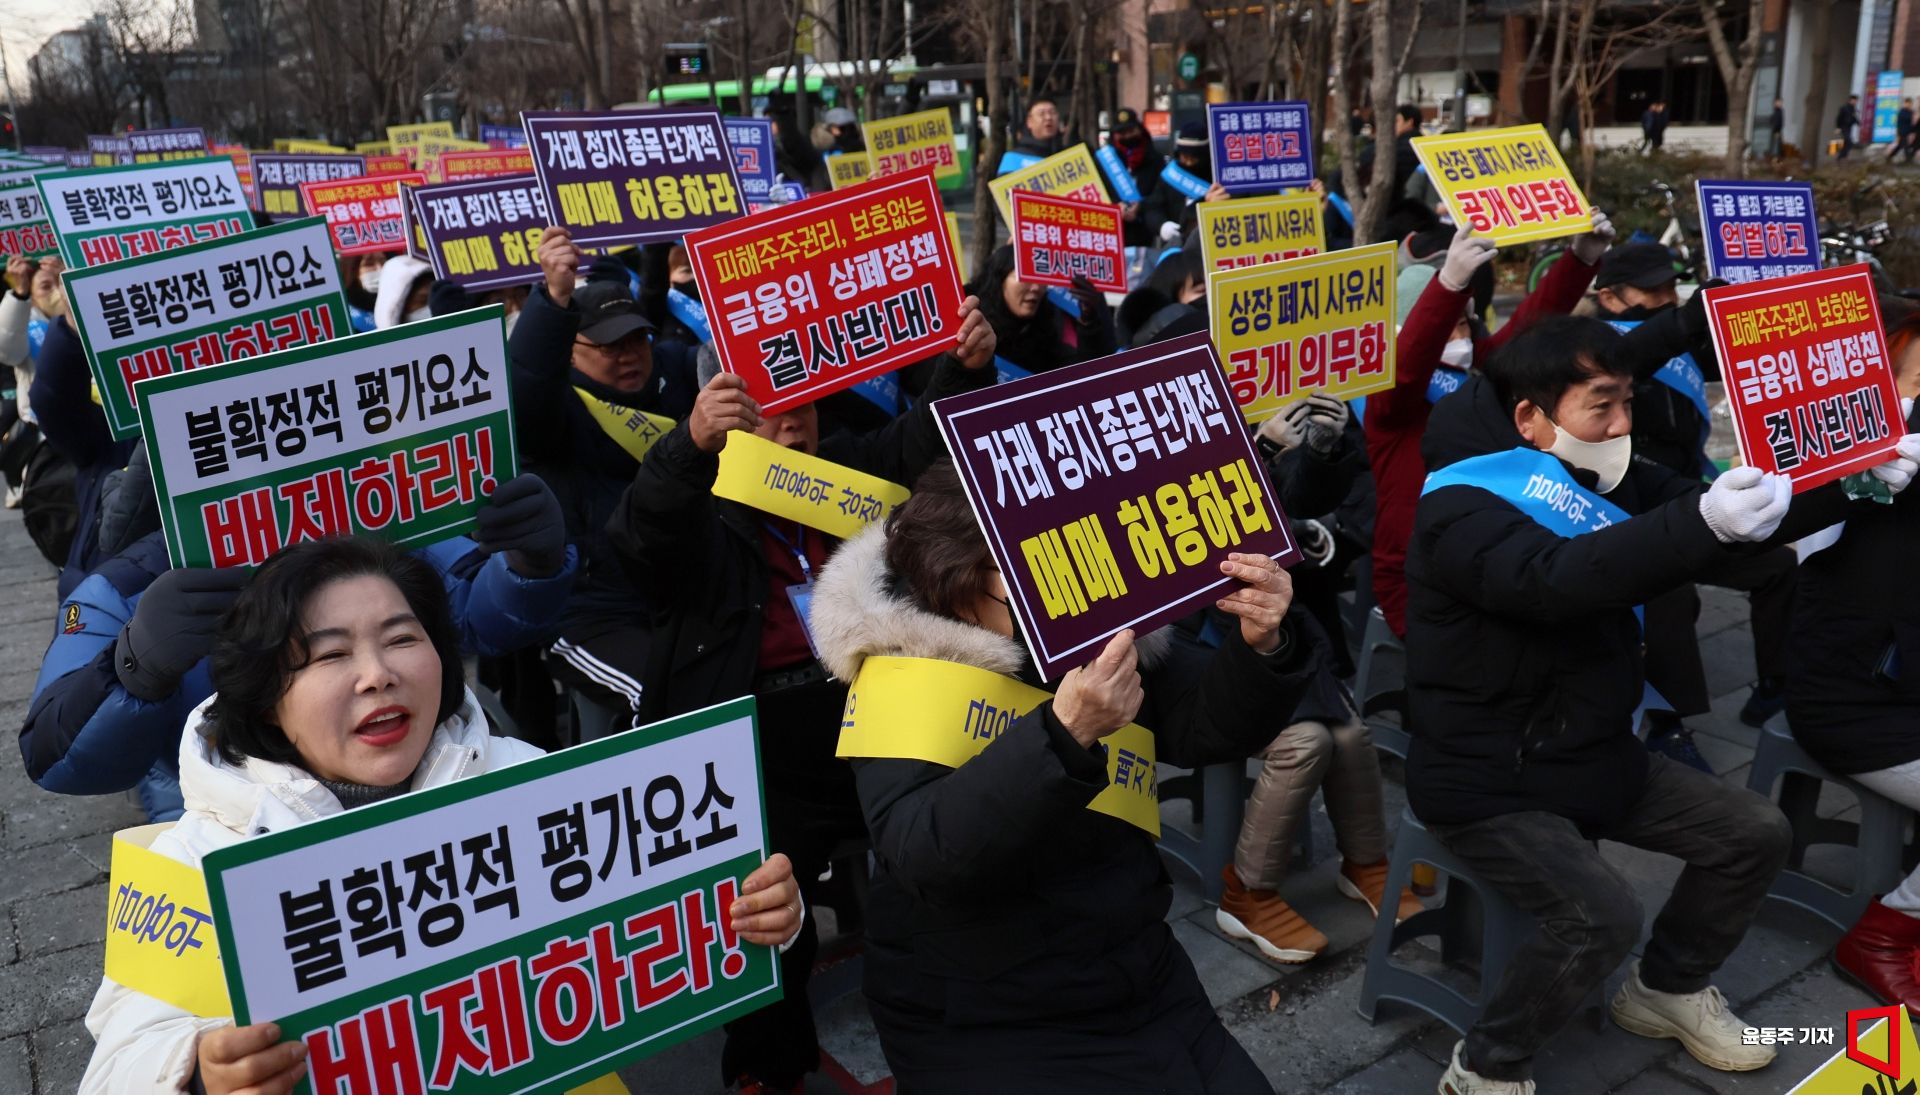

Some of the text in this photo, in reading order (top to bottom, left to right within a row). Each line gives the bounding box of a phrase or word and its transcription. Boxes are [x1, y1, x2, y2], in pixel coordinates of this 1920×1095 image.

[541, 130, 587, 170] 거래
[583, 128, 627, 170] 정지
[622, 127, 666, 166] 종목
[660, 123, 721, 164] 단계적
[873, 128, 895, 150] 상장
[918, 118, 948, 139] 사유서
[1219, 113, 1239, 131] 금융
[1264, 111, 1301, 129] 카르텔은
[1224, 131, 1301, 161] 엄벌하고
[258, 163, 283, 184] 거래
[1053, 157, 1089, 186] 사유서
[1435, 140, 1556, 181] 상장 폐지 사유서
[62, 183, 152, 226] 불확정적
[152, 174, 236, 214] 평가요소
[427, 196, 467, 230] 거래
[463, 192, 502, 227] 정지
[497, 187, 535, 223] 종목
[557, 180, 623, 226] 매매
[625, 172, 739, 220] 허용하라
[1021, 202, 1115, 230] 피해주주권리, 보호없는
[1456, 178, 1584, 232] 공개 의무화
[1712, 194, 1806, 217] 금융 범죄 카르텔은
[712, 195, 928, 284] 피해주주권리, 보호없는
[1021, 222, 1119, 254] 금융위 상폐정책
[1212, 207, 1315, 248] 상장 폐지 사유서
[1719, 221, 1808, 259] 엄벌하고
[442, 235, 499, 275] 매매
[1032, 248, 1115, 282] 결사반대!
[98, 245, 327, 340] 불확정적 평가요소
[723, 271, 819, 337] 금융위
[827, 231, 942, 300] 상폐정책
[1228, 265, 1384, 336] 상장 폐지 사유서
[758, 283, 945, 392] 결사반대!
[1726, 290, 1870, 347] 피해주주권리, 보호없는
[1228, 320, 1387, 408] 공개 의무화
[1736, 349, 1803, 405] 금융위
[1807, 331, 1883, 387] 상폐정책
[185, 347, 492, 478] 불확정적 평가요소
[973, 369, 1231, 508] 거래 정지 종목 단계적
[1764, 384, 1889, 472] 결사반대!
[202, 426, 498, 569] 배제하라!
[1020, 459, 1272, 620] 매매 허용하라
[279, 761, 739, 993] 불확정적 평가요소
[304, 877, 747, 1095] 배제하라!
